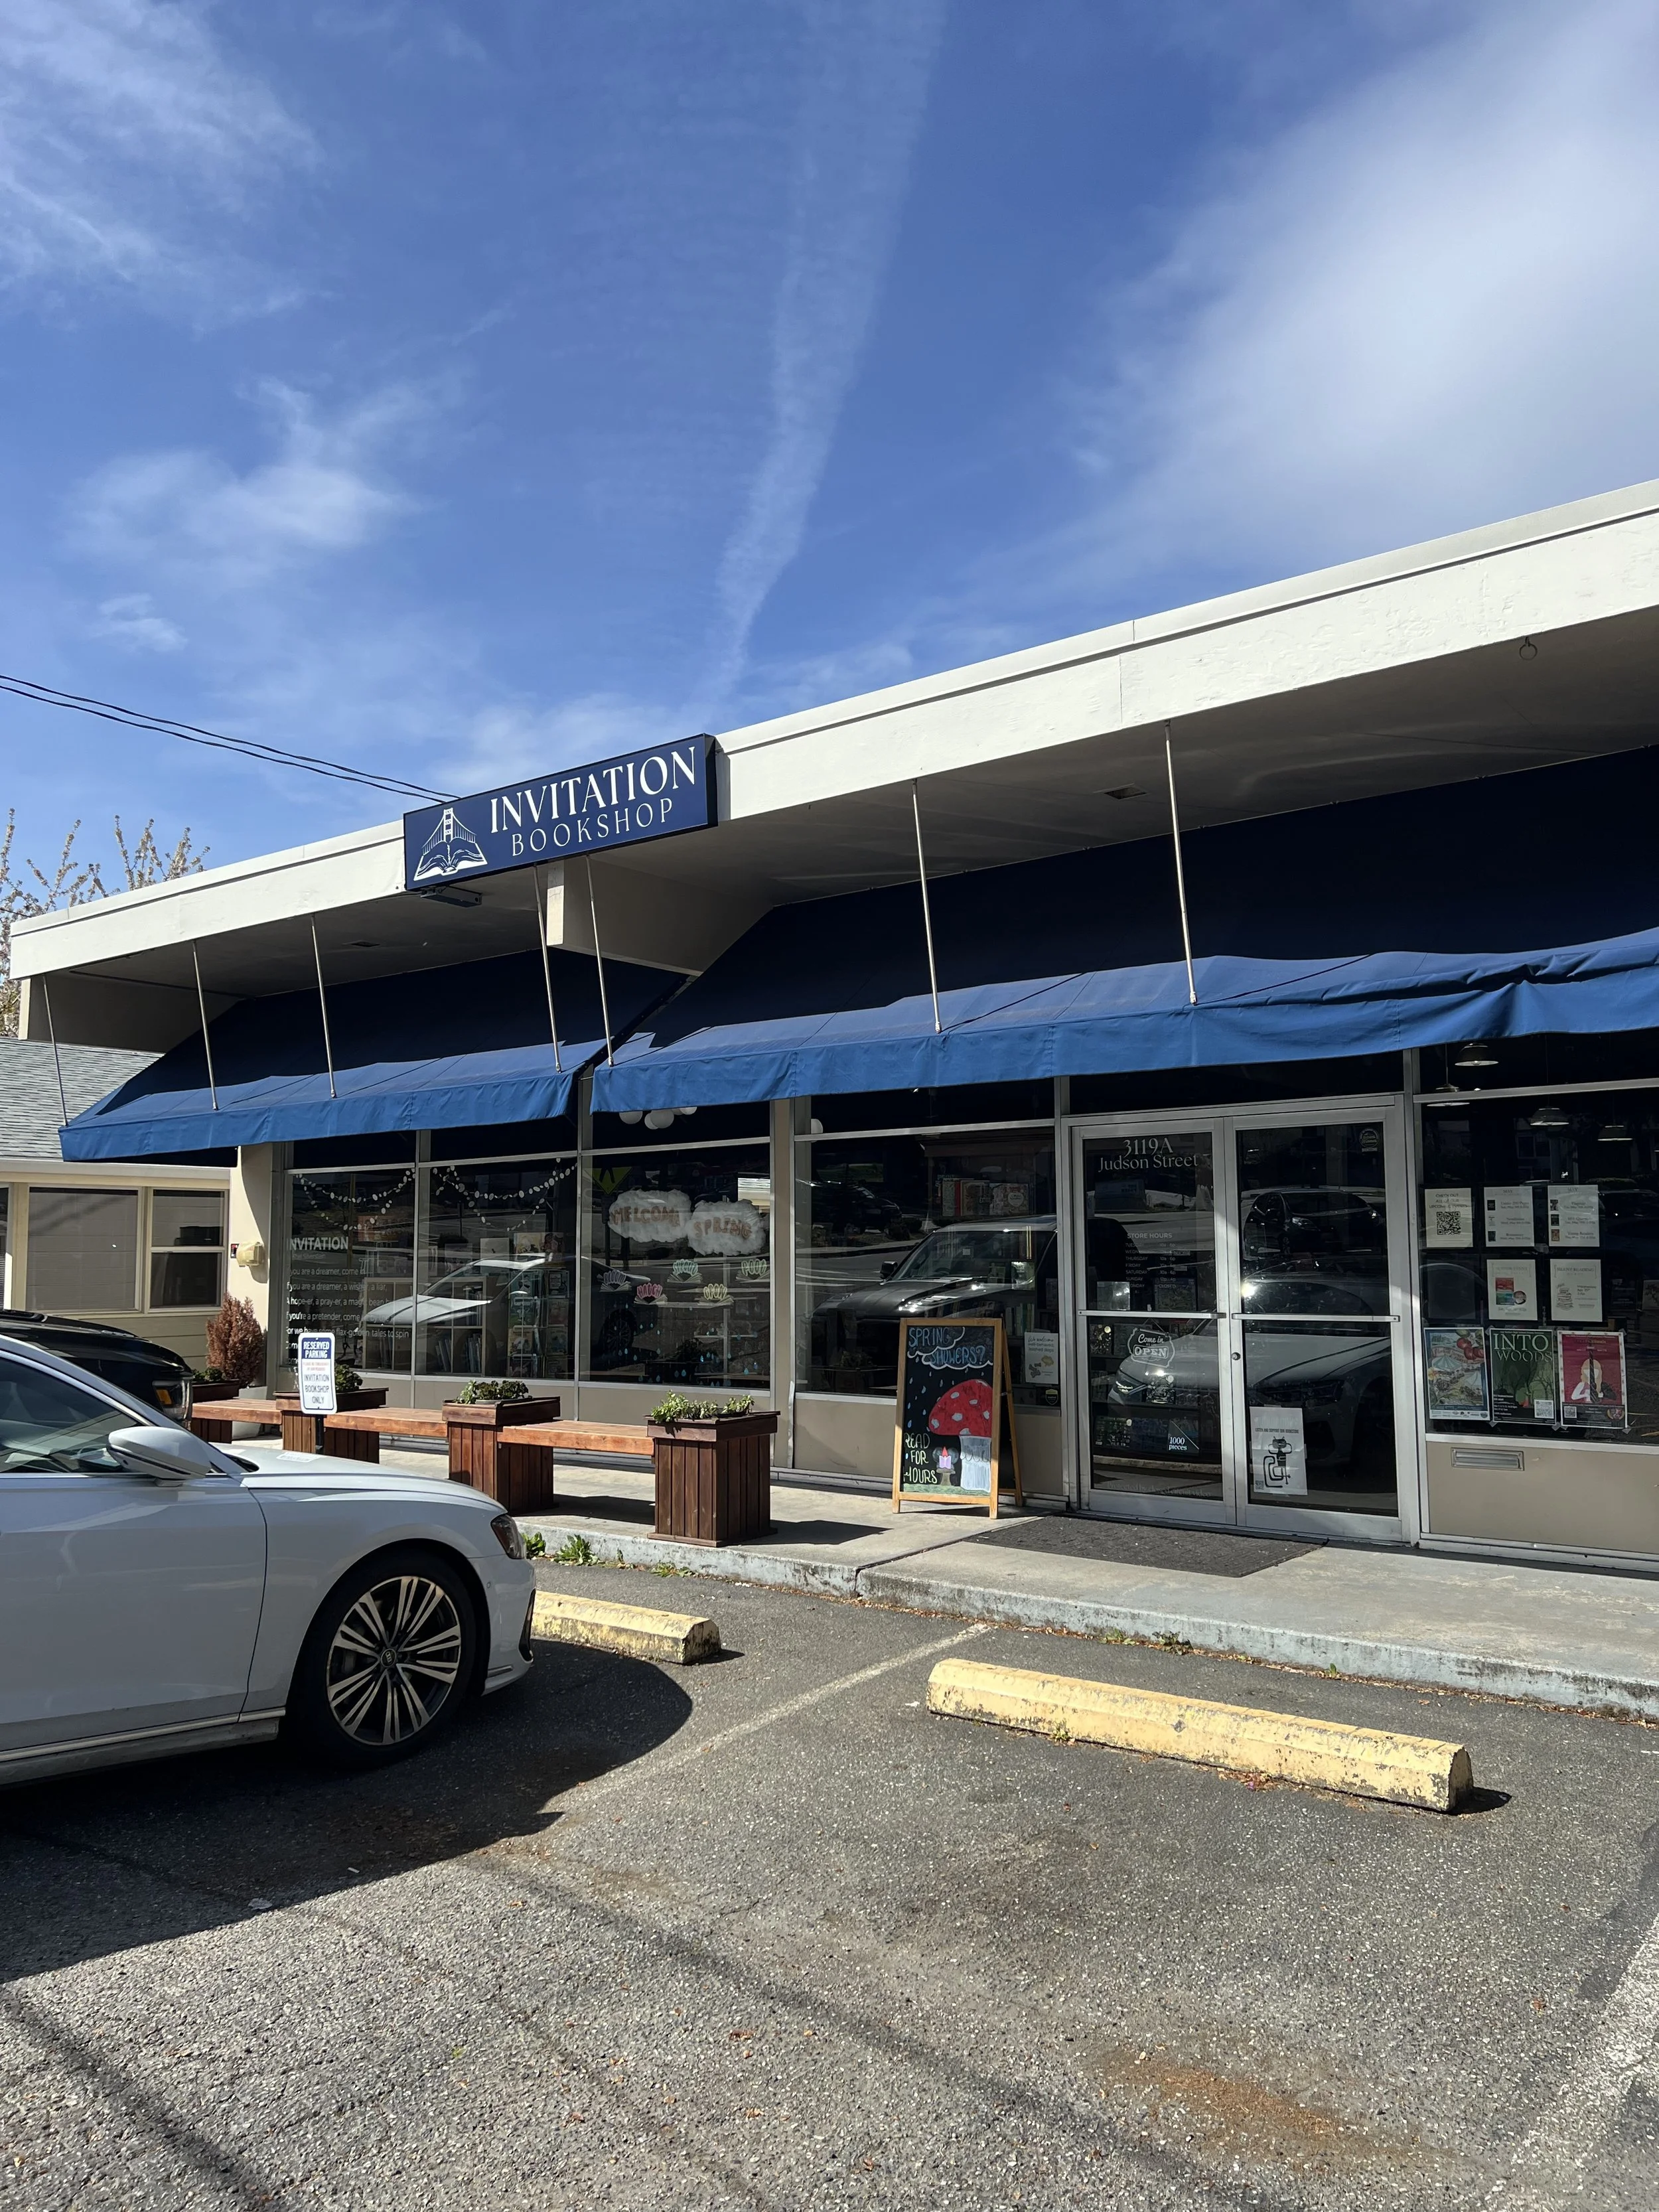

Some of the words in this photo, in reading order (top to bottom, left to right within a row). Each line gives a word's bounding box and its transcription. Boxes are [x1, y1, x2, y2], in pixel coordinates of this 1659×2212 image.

[490, 746, 696, 834] INVITATION
[512, 797, 673, 857] BOOKSHOP
[1123, 1138, 1173, 1158] 3119A
[1098, 1155, 1149, 1173] Judson
[1153, 1155, 1199, 1168] Street
[287, 1236, 349, 1250] INVITATION
[290, 1283, 300, 1291] you
[317, 1282, 342, 1291] dreamer,
[289, 1313, 306, 1321] you're
[372, 1329, 386, 1337] tales
[396, 1329, 409, 1339] spin
[908, 1327, 951, 1347] SPRING
[1137, 1333, 1157, 1343] Come
[1493, 1333, 1549, 1352] INTO
[305, 1350, 328, 1359] PARKING
[930, 1345, 985, 1364] SHOWERS?
[1135, 1346, 1167, 1358] OPEN
[1496, 1349, 1553, 1363] WOODS
[305, 1384, 330, 1393] BOOKSHOP
[904, 1433, 930, 1449] READ
[910, 1450, 929, 1465] FOR
[903, 1467, 938, 1484] HOURS
